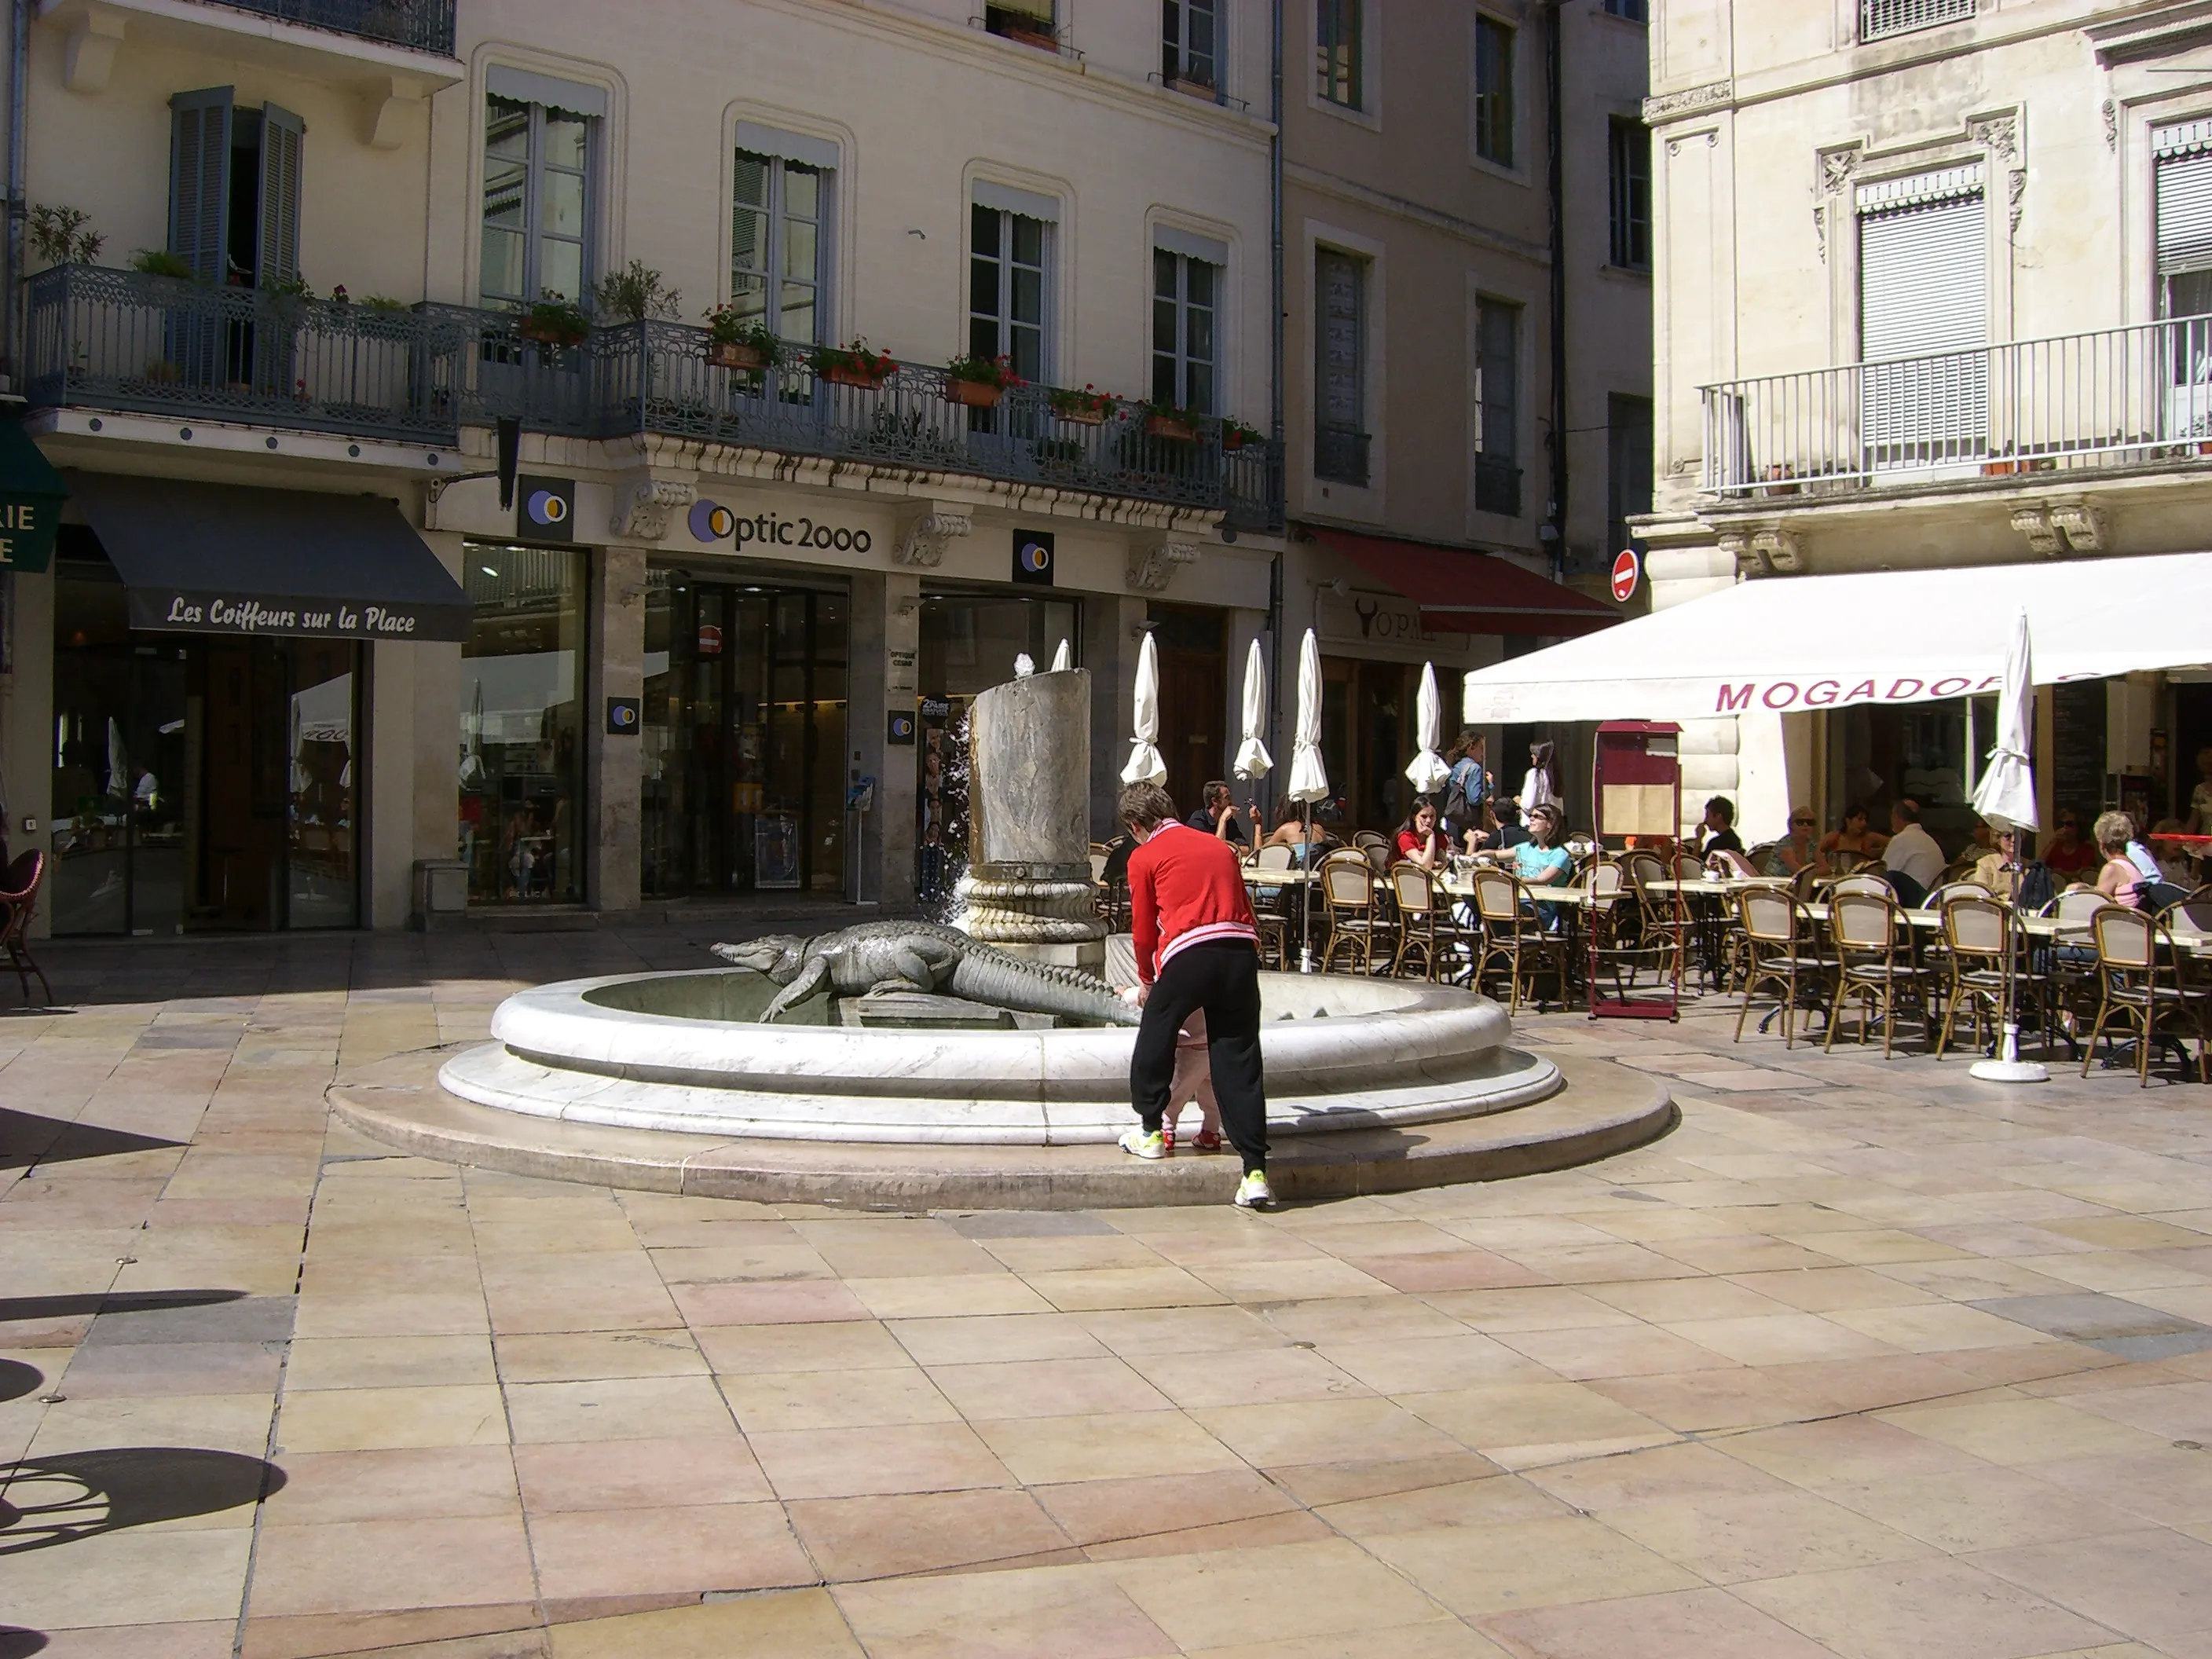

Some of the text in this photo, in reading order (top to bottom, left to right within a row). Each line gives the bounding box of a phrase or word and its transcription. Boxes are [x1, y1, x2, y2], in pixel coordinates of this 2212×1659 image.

[167, 597, 416, 632] Les Coiffeurs sur la Place
